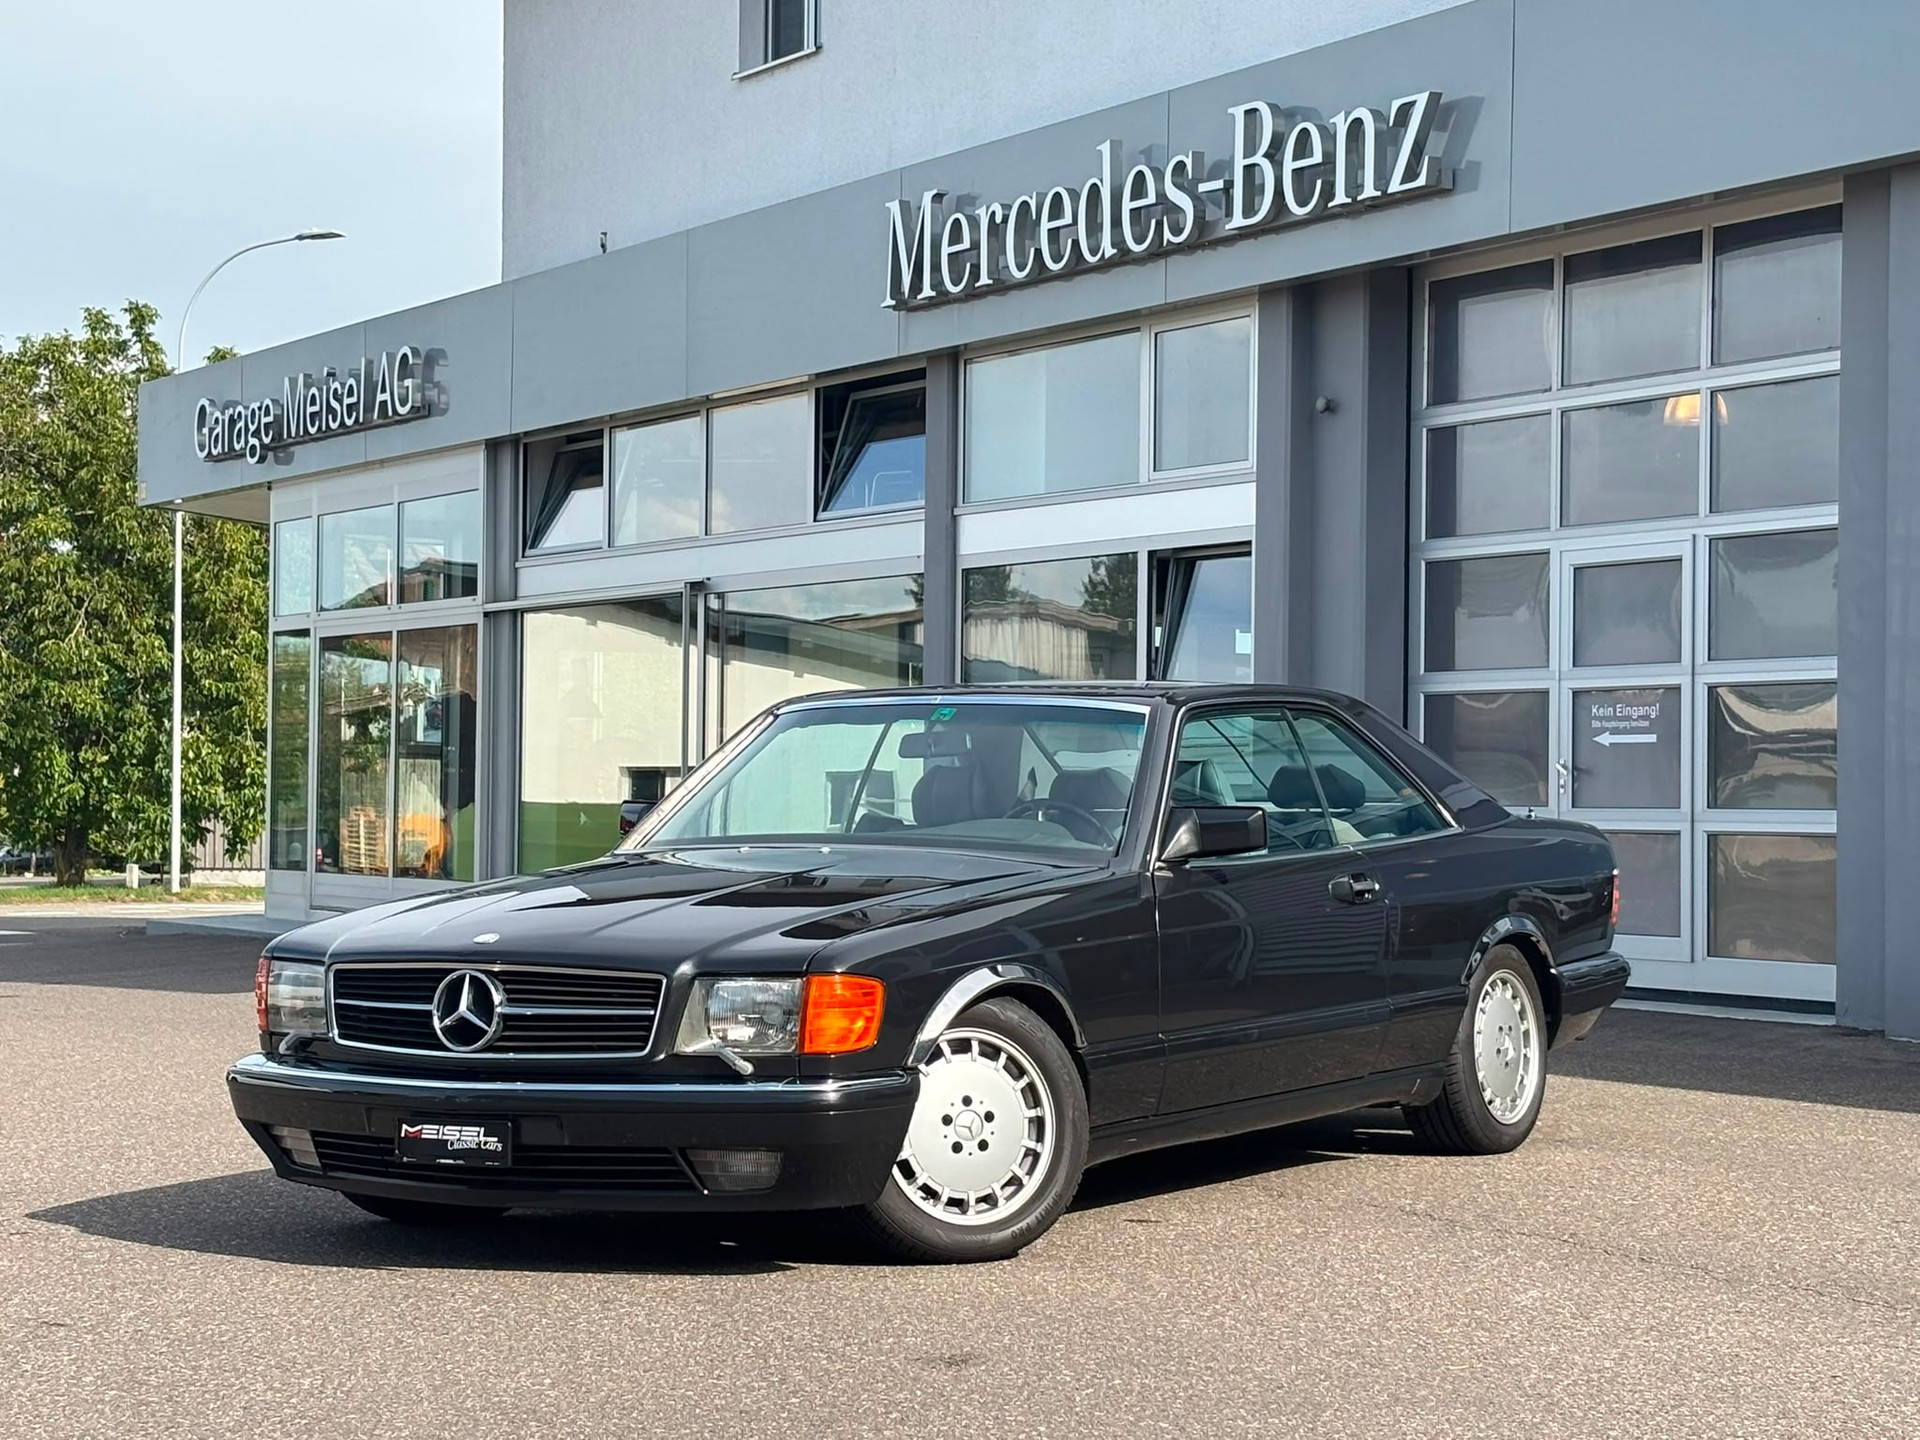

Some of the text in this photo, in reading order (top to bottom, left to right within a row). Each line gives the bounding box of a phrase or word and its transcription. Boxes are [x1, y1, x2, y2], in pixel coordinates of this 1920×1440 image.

[881, 90, 1443, 309] Mercedes-Benz
[194, 345, 413, 464] Garage Meisel AG
[1591, 702, 1660, 719] Kein Eingang!
[400, 1123, 498, 1142] MEISEL
[447, 1139, 504, 1152] Classic Cars
